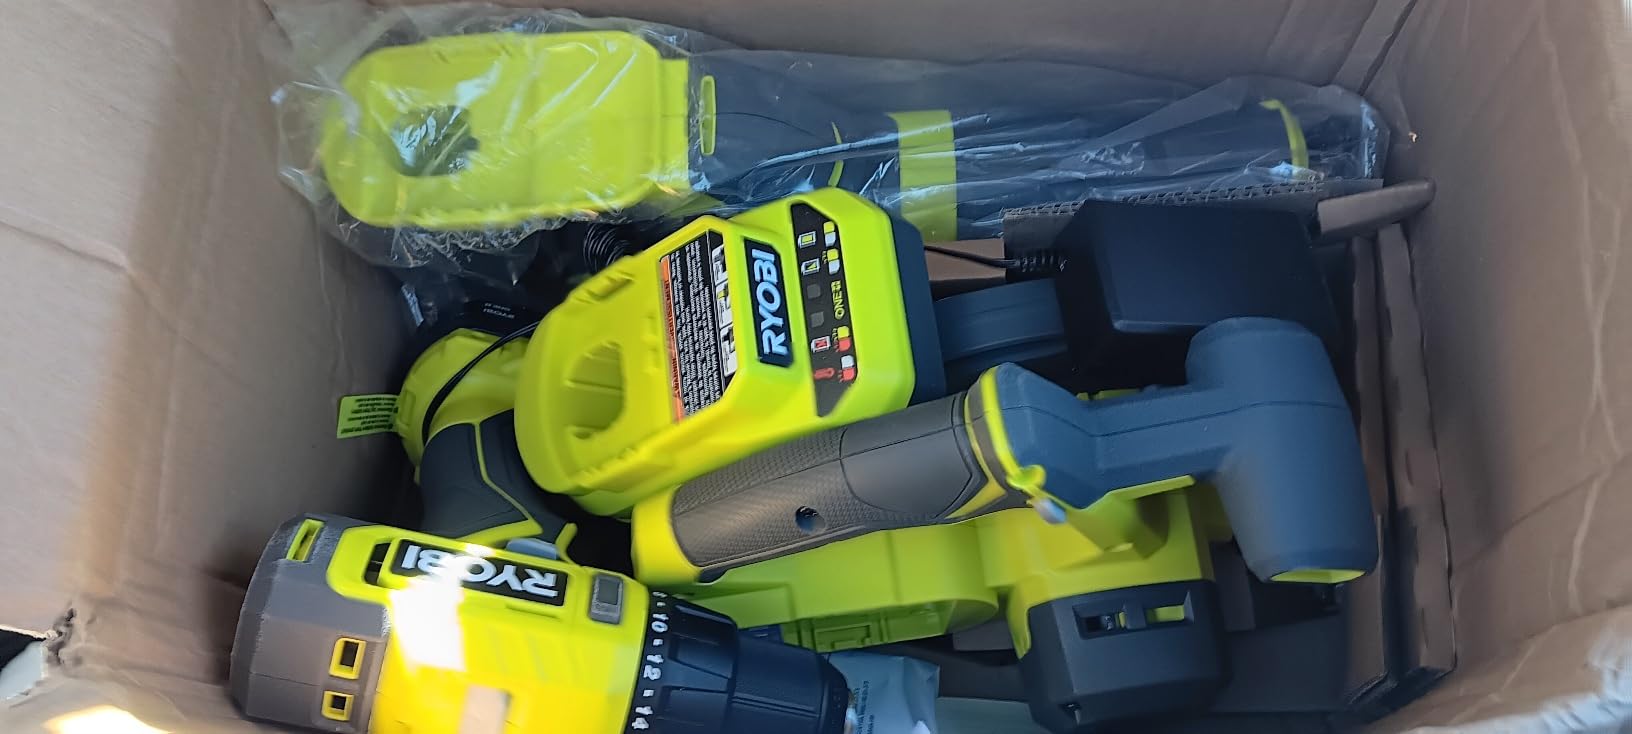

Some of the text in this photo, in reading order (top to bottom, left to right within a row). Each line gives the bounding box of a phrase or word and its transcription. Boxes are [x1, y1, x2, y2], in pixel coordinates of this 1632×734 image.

[751, 248, 788, 356] RYOBI
[400, 544, 559, 599] RYOBI
[651, 613, 669, 633] 10
[643, 654, 664, 681] 12
[632, 704, 653, 730] 14
